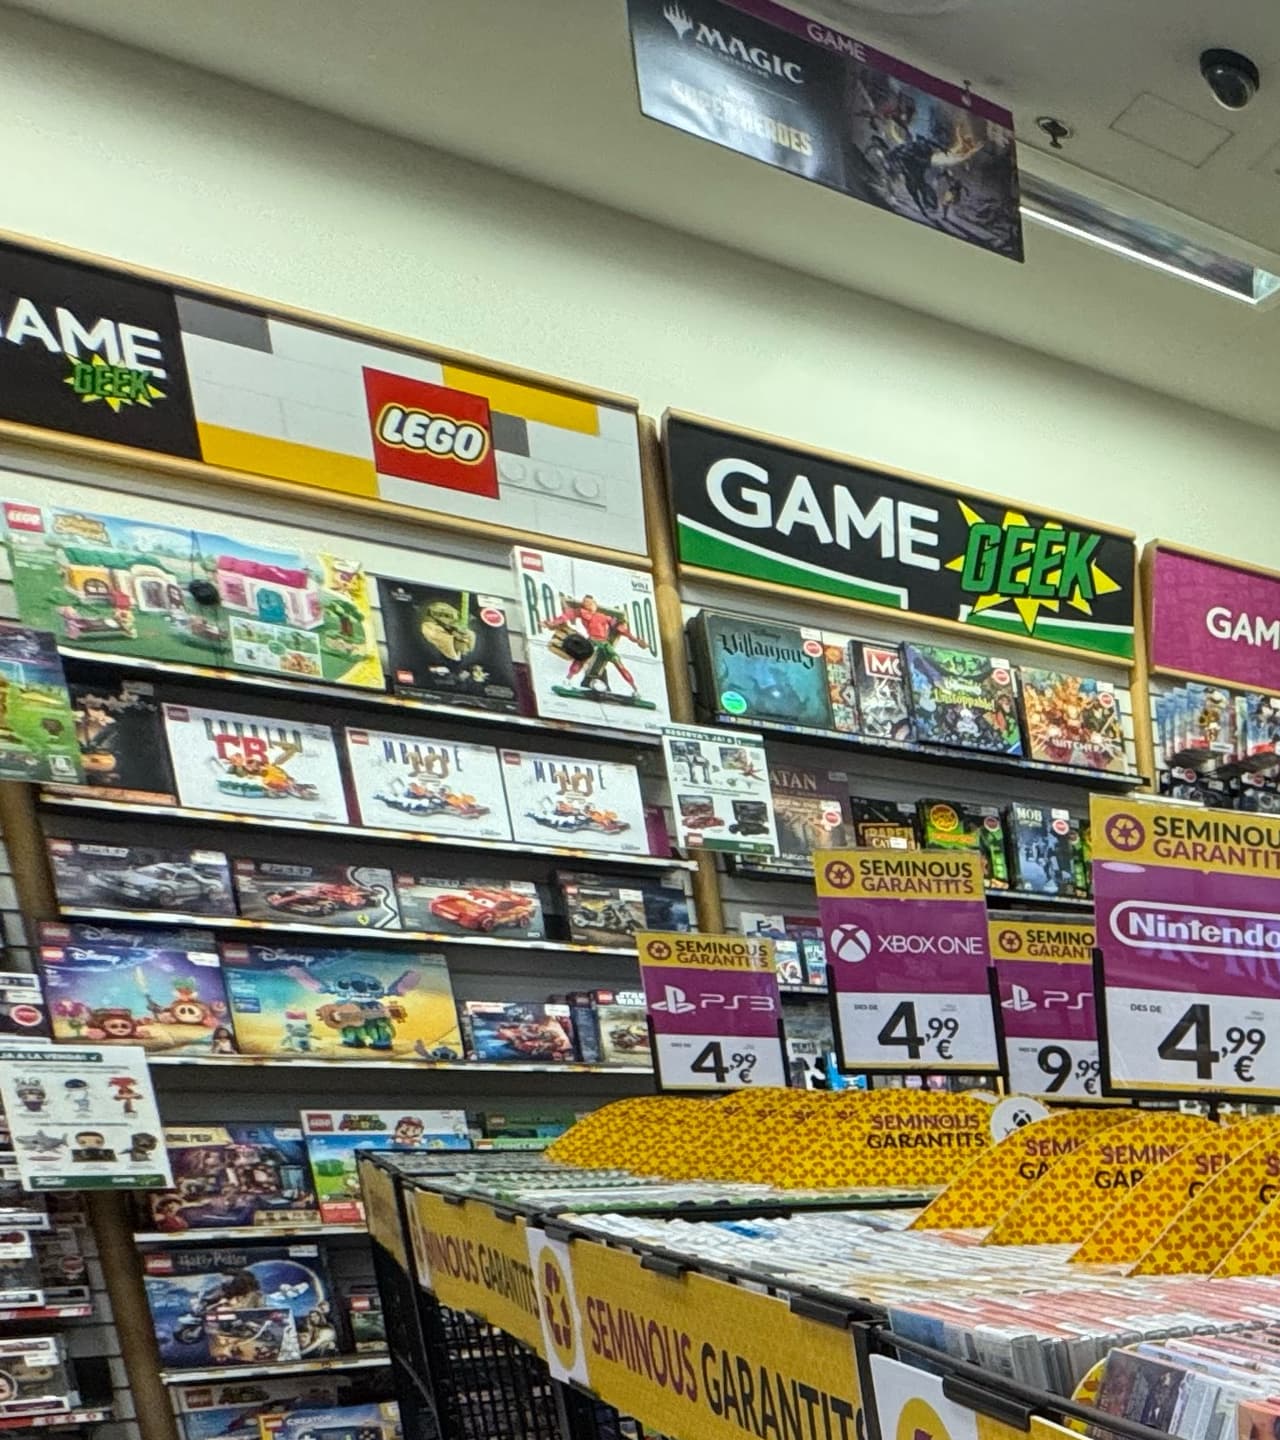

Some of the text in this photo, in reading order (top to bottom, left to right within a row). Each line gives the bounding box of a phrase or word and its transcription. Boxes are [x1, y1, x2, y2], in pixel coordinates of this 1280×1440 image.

[695, 23, 805, 84] MAGIC
[0, 297, 167, 379] AME
[72, 360, 153, 400] GEEK
[380, 405, 485, 461] LEGO
[706, 457, 1102, 600] GAME GEEK
[859, 857, 974, 881] SEMINOUS
[860, 874, 975, 895] GARANTITS
[675, 938, 768, 958] SEMINOUS
[676, 952, 769, 969] GARANTITS
[936, 1039, 953, 1061] €
[1232, 1054, 1255, 1083] €
[871, 1112, 981, 1132] SEMINOUS
[866, 1132, 987, 1151] GARANTITS
[586, 1296, 698, 1402] SEMINOUS
